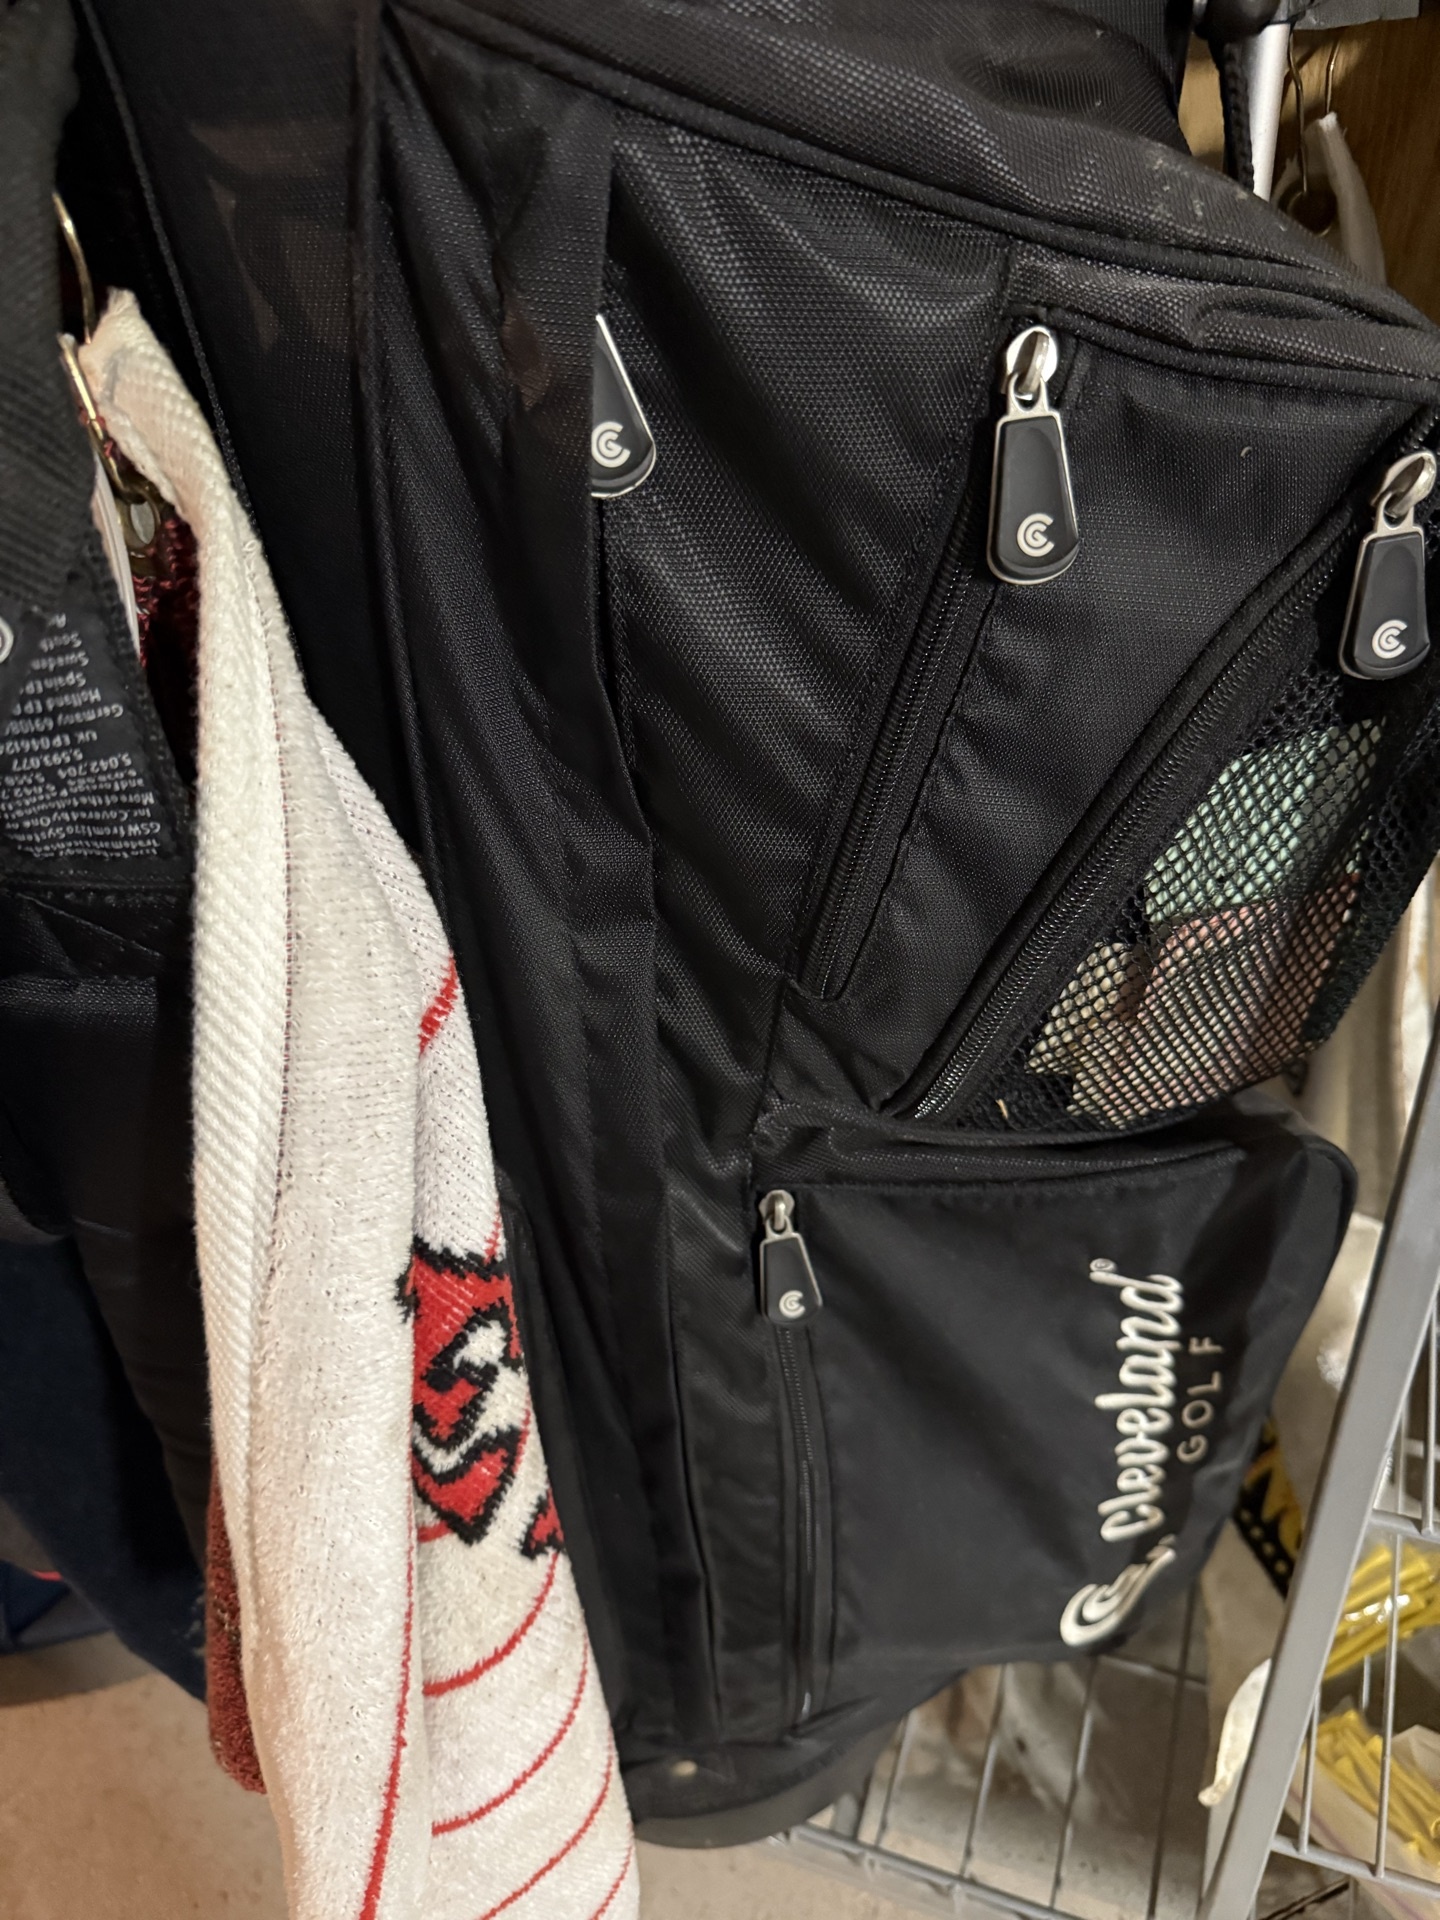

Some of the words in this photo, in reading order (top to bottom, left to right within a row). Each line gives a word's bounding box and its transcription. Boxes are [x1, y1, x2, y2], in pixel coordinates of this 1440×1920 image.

[31, 651, 89, 672] Sweden
[44, 671, 87, 692] Spain
[45, 687, 101, 712] Holland
[57, 703, 124, 726] Germany
[75, 730, 98, 744] UK
[120, 791, 155, 806] More
[23, 816, 51, 829] One
[92, 825, 125, 838] from
[126, 821, 161, 837] GSW
[1177, 1336, 1224, 1463] GOLF
